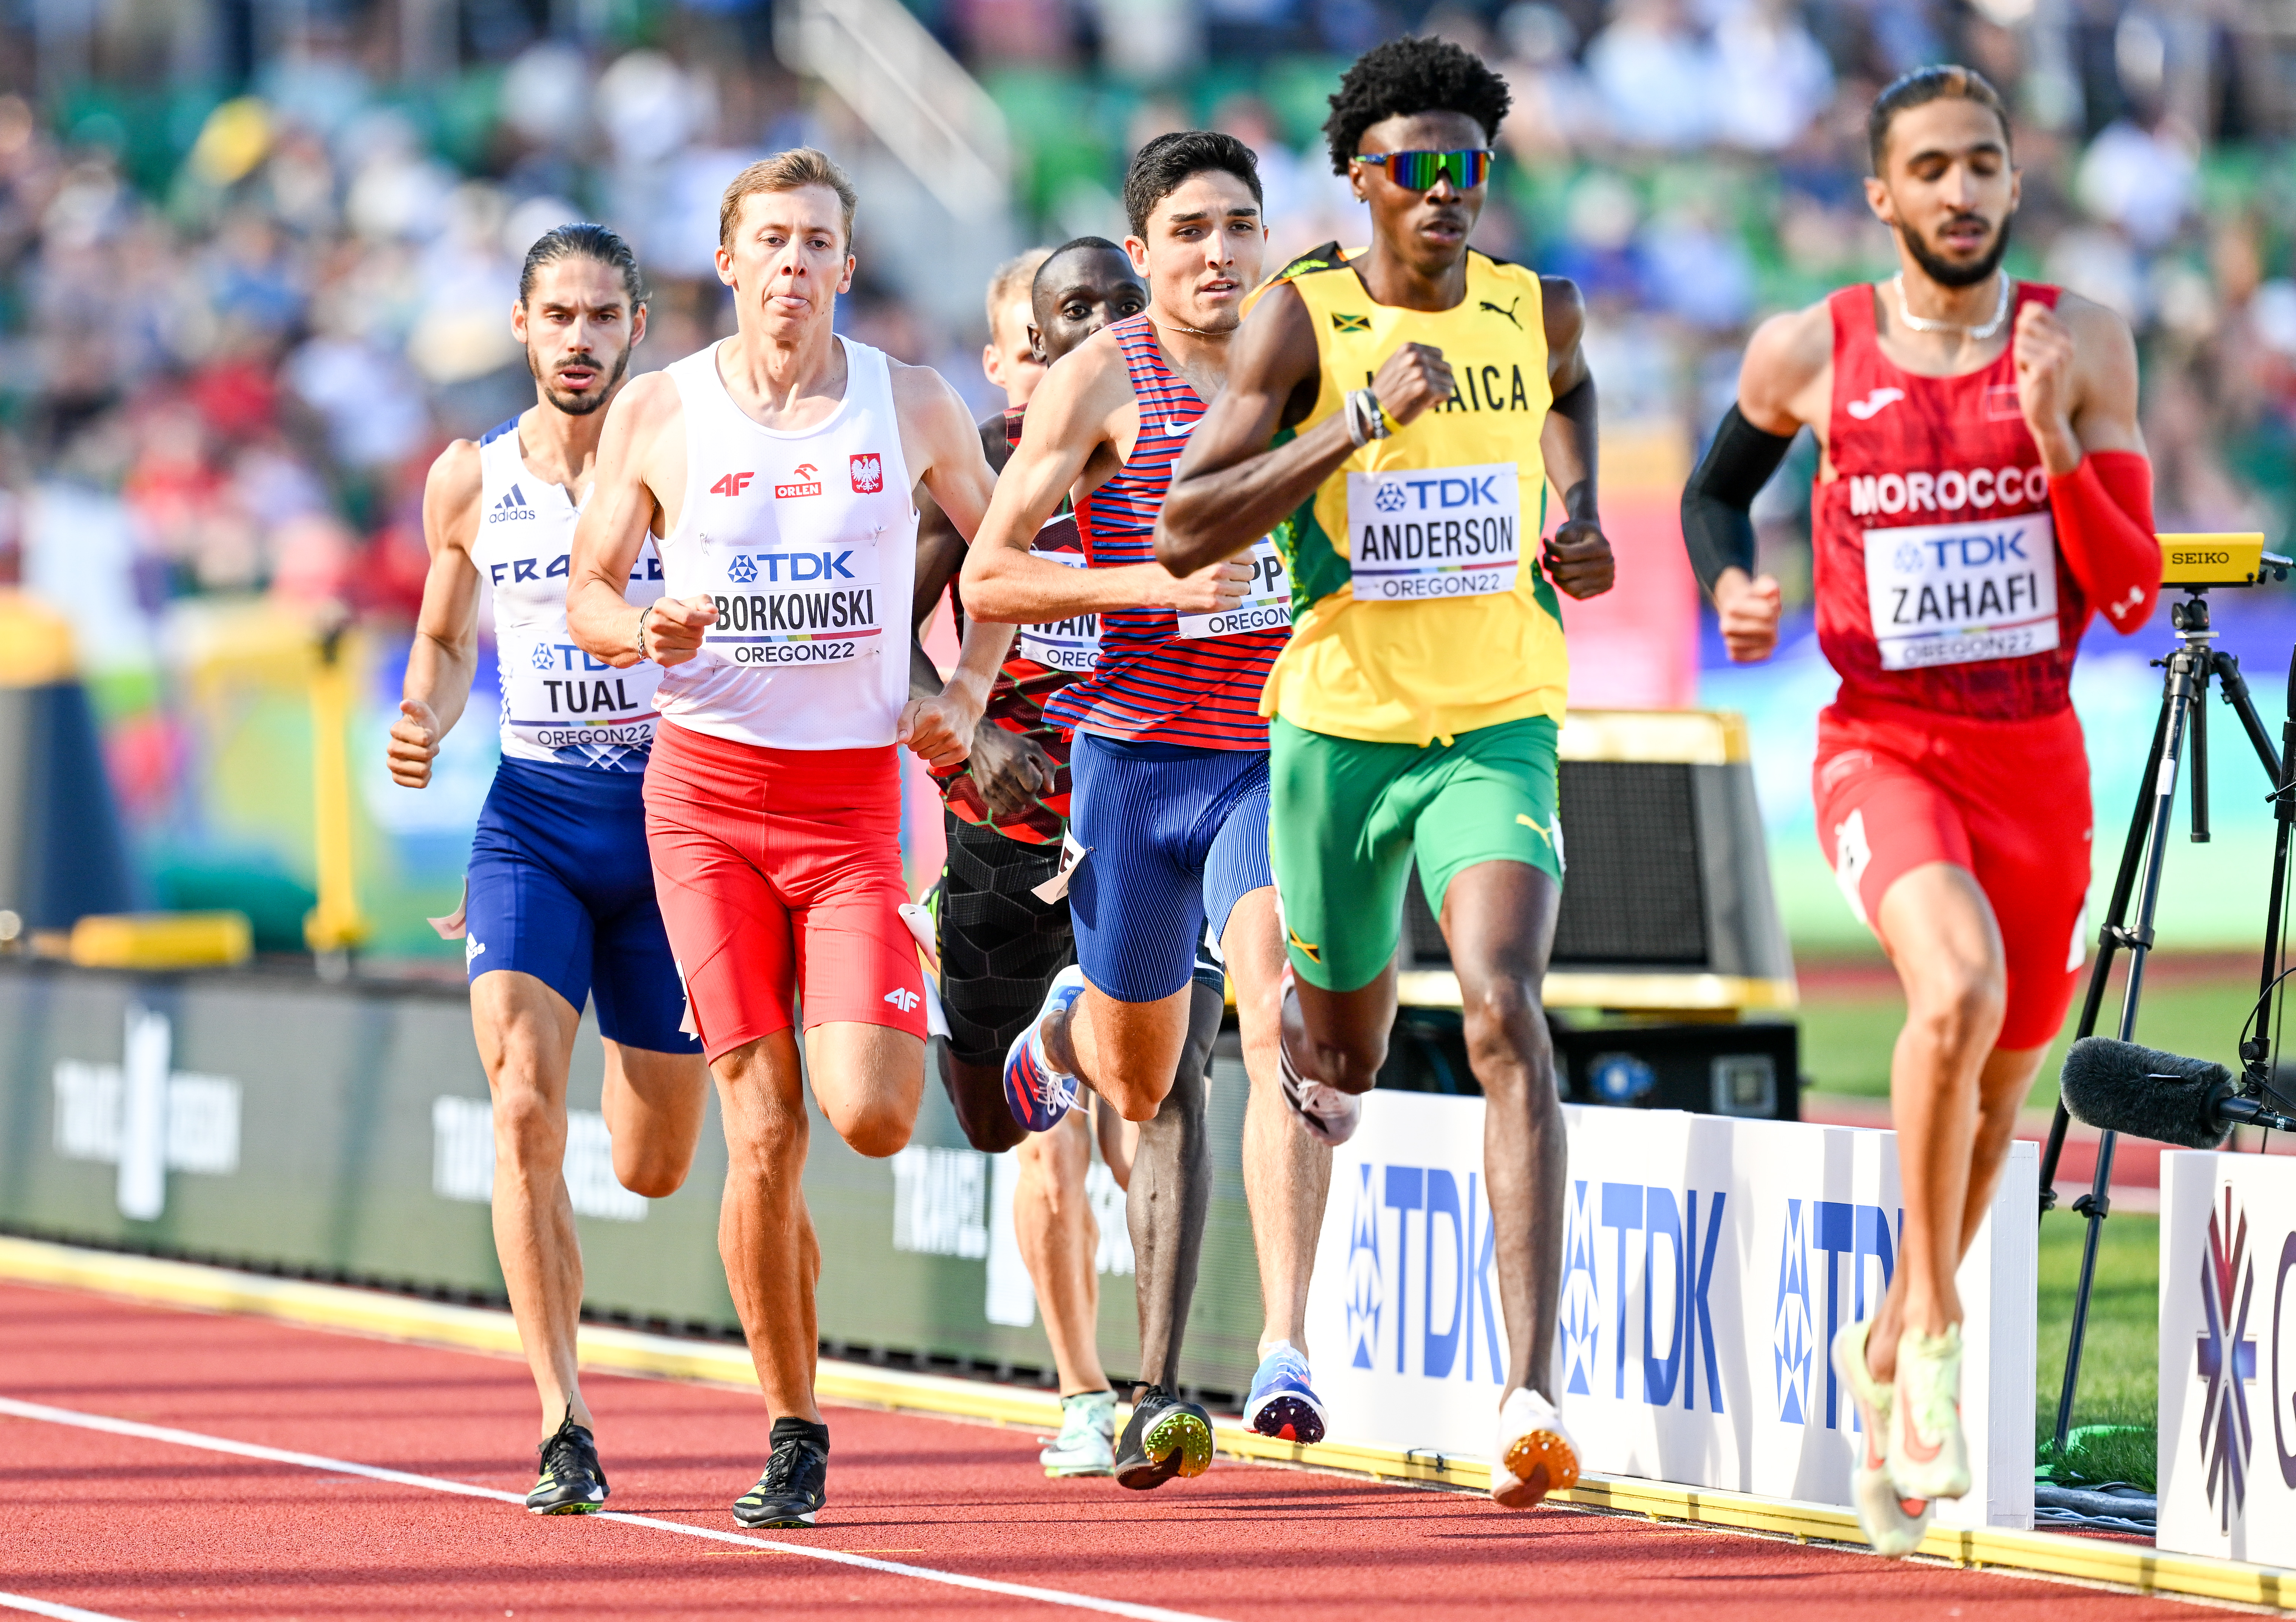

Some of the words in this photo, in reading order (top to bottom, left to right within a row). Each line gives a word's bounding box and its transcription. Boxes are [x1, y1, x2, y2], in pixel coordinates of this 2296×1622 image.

[1366, 364, 1528, 412] AICA
[710, 472, 754, 497] 4F
[777, 484, 819, 497] ORLEN
[1406, 476, 1499, 509] TDK
[1849, 466, 2048, 516] MOROCCO
[490, 508, 536, 523] adidas
[1361, 516, 1513, 561] ANDERSON
[1926, 530, 2028, 569] TDK
[491, 555, 664, 586] FRAE
[757, 550, 856, 582] TDK
[2172, 552, 2229, 564] SEIKO
[1383, 574, 1500, 598] OREGON22
[1892, 572, 2037, 624] ZAHAFI
[715, 589, 873, 631] BORKOWSKI
[735, 642, 855, 663] OREGON22
[544, 678, 638, 713] TUAL
[538, 724, 654, 746] OREGON22
[884, 987, 920, 1013] 4F
[1385, 1165, 1505, 1385] TDK
[1602, 1183, 1726, 1413] TDK
[1813, 1200, 1904, 1432] TD
